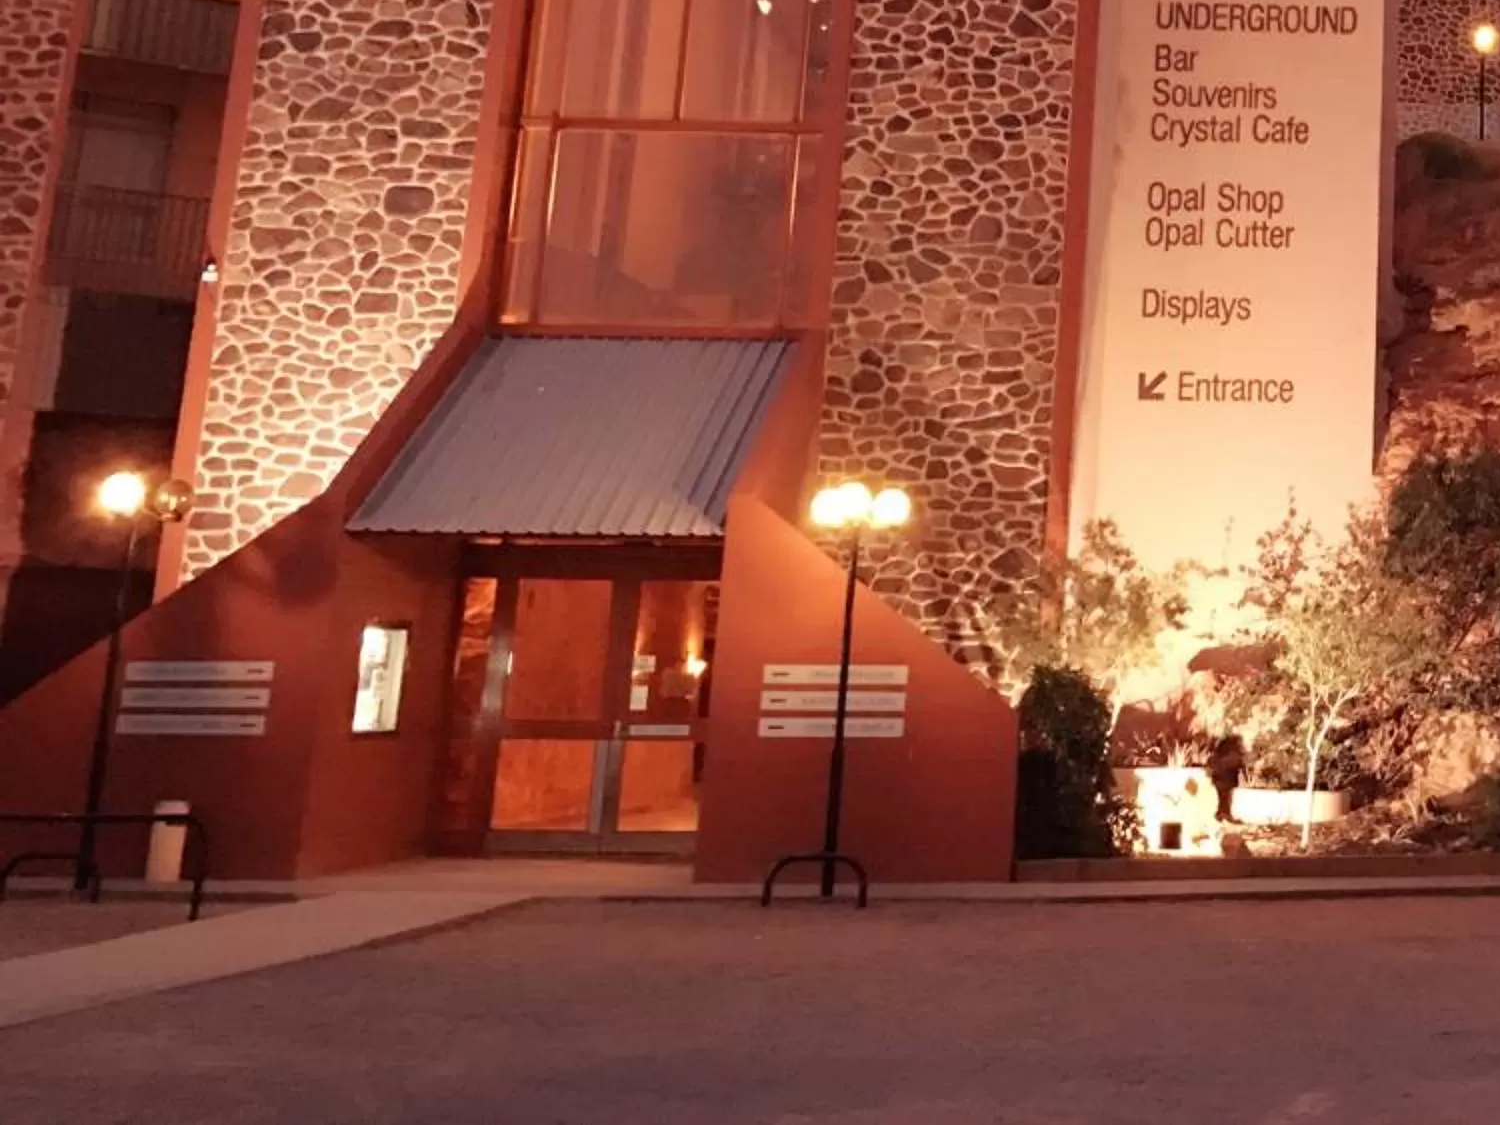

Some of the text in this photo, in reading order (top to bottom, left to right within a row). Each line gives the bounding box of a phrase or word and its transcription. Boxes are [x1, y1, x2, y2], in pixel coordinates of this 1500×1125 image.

[1156, 1, 1359, 35] UNDERGROUND
[1154, 44, 1198, 72] Bar
[1152, 78, 1278, 109] Souvenirs
[1150, 112, 1310, 148] Crystal Cafe
[1147, 181, 1284, 219] Opal Shop
[1145, 217, 1295, 251] Opal Cutter
[1141, 287, 1252, 326] Displays
[1177, 371, 1295, 403] Entrance
